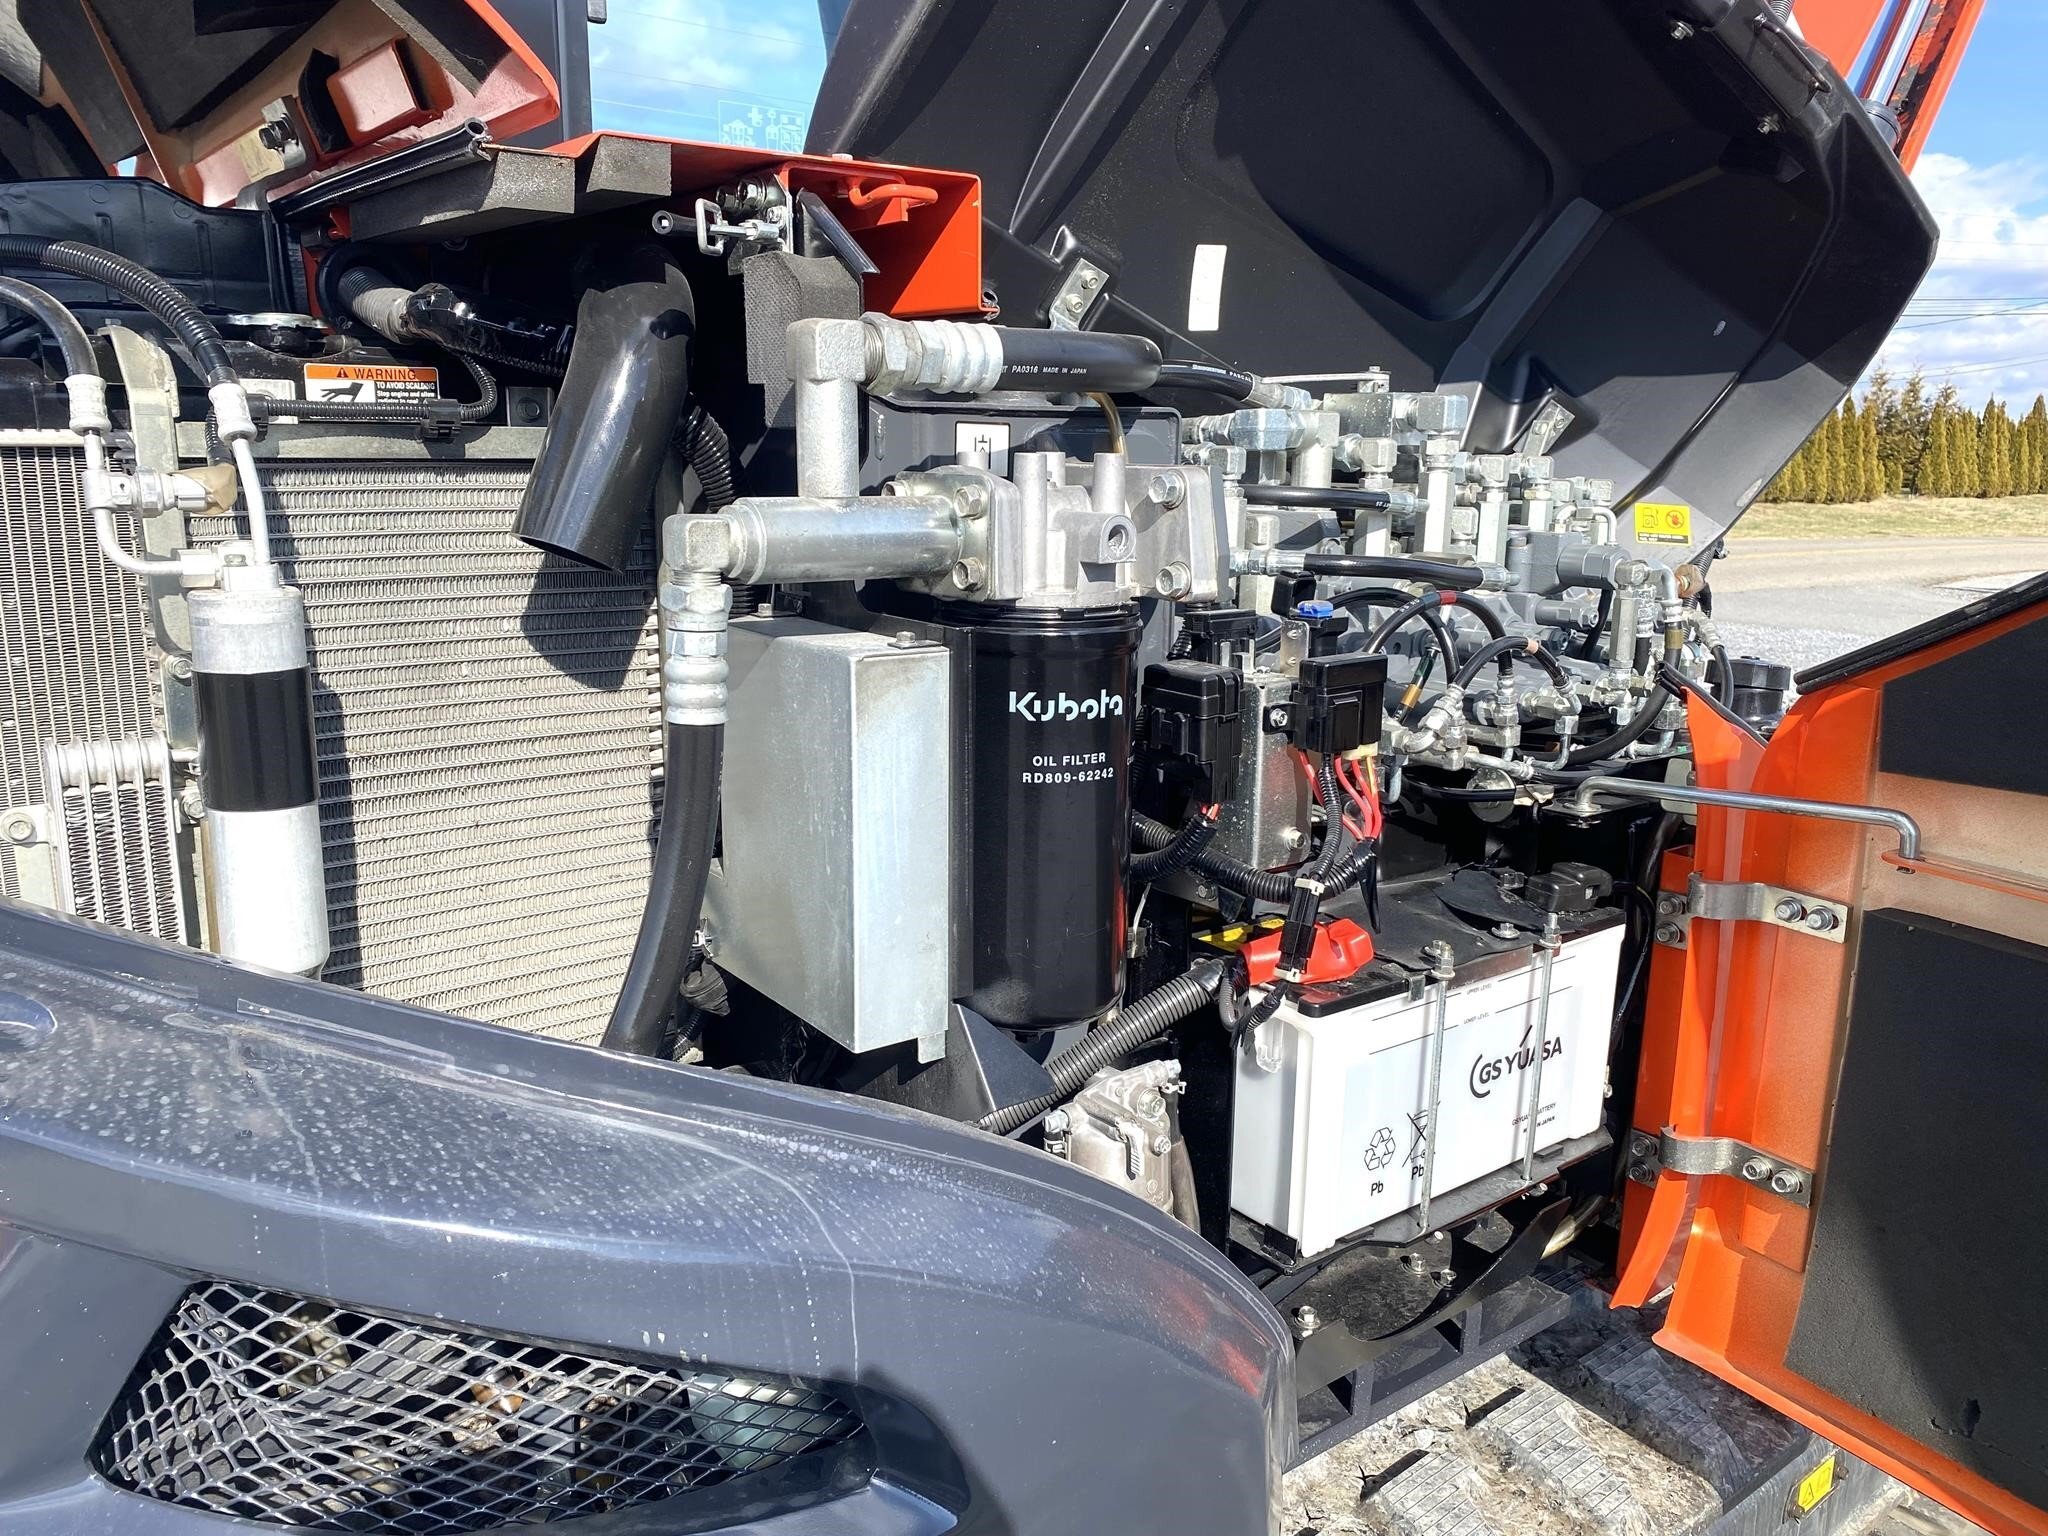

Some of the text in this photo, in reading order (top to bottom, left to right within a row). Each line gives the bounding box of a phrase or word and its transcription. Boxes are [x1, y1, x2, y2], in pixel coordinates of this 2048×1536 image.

[354, 368, 416, 380] WARNING
[1011, 365, 1039, 374] PA0316
[1042, 366, 1059, 374] MADE
[375, 381, 385, 389] TO
[386, 381, 405, 390] AVOID
[376, 390, 390, 398] Stop
[390, 390, 409, 398] engine
[1008, 689, 1123, 721] Kubota
[1032, 752, 1106, 767] OIL FILTER
[1022, 767, 1114, 783] RD809-62242
[1463, 1016, 1476, 1024] LOWER
[1411, 1164, 1425, 1180] Pb
[1370, 1180, 1384, 1196] Pb
